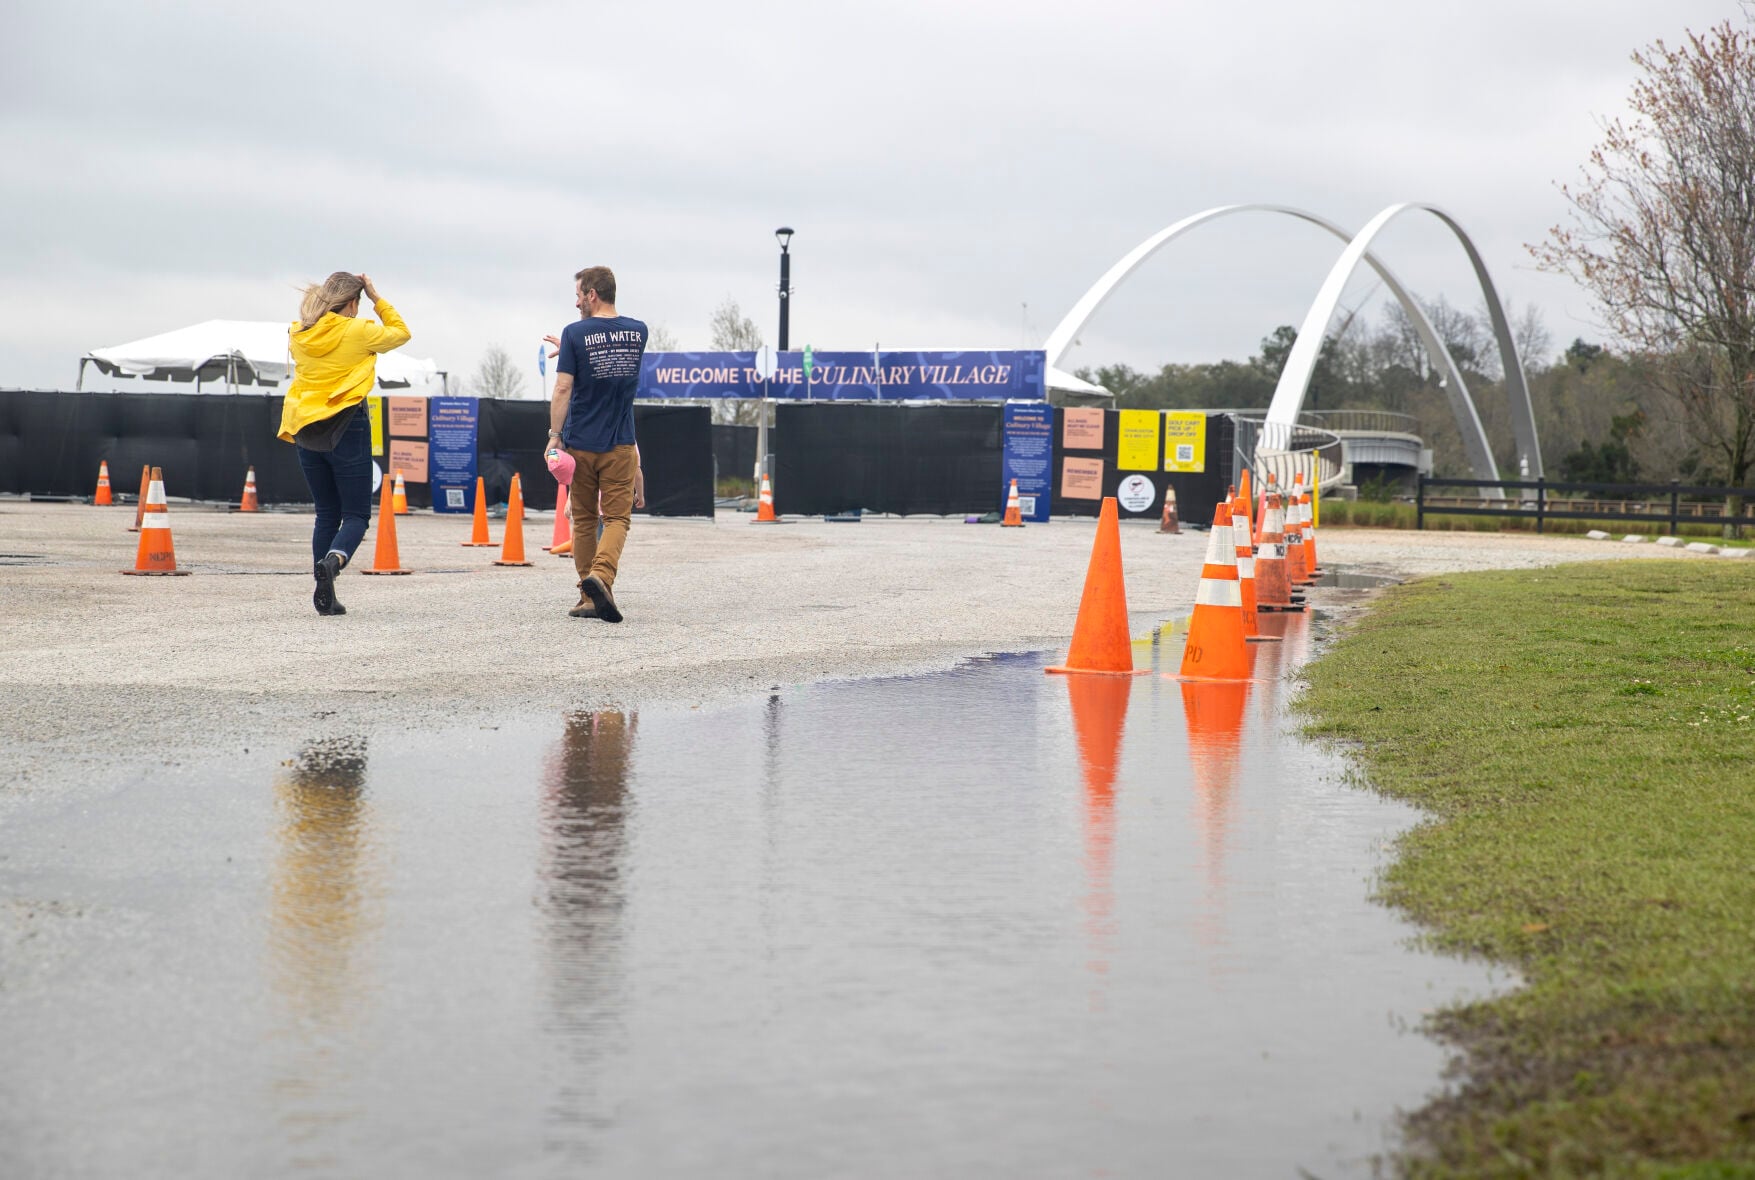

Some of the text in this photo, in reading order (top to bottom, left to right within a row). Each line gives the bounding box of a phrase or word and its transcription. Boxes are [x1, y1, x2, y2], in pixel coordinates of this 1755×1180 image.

[584, 330, 642, 346] HIGH WATER
[656, 367, 739, 384] WELCOME
[771, 368, 802, 384] THE
[809, 365, 917, 385] CULINARY
[919, 365, 1011, 385] VILLAGE
